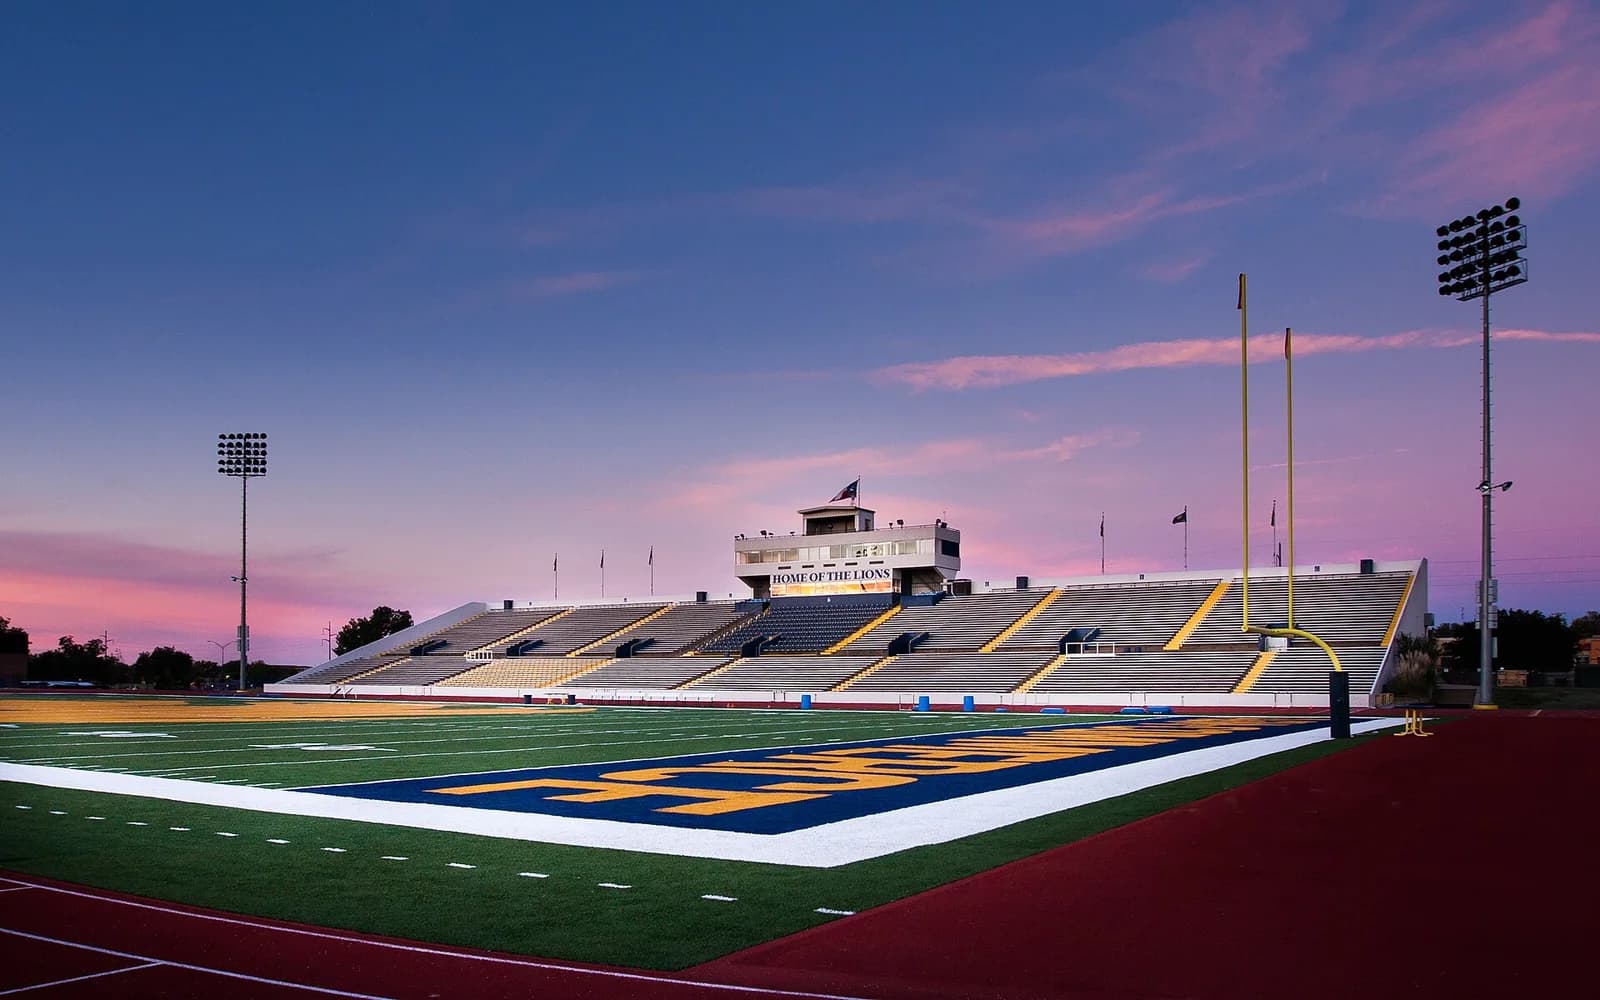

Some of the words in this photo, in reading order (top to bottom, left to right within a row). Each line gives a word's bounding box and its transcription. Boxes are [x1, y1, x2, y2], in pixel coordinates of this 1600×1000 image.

[773, 573, 807, 584] HOME
[809, 572, 825, 582] OF
[826, 571, 851, 581] THE
[854, 569, 890, 580] LIONS
